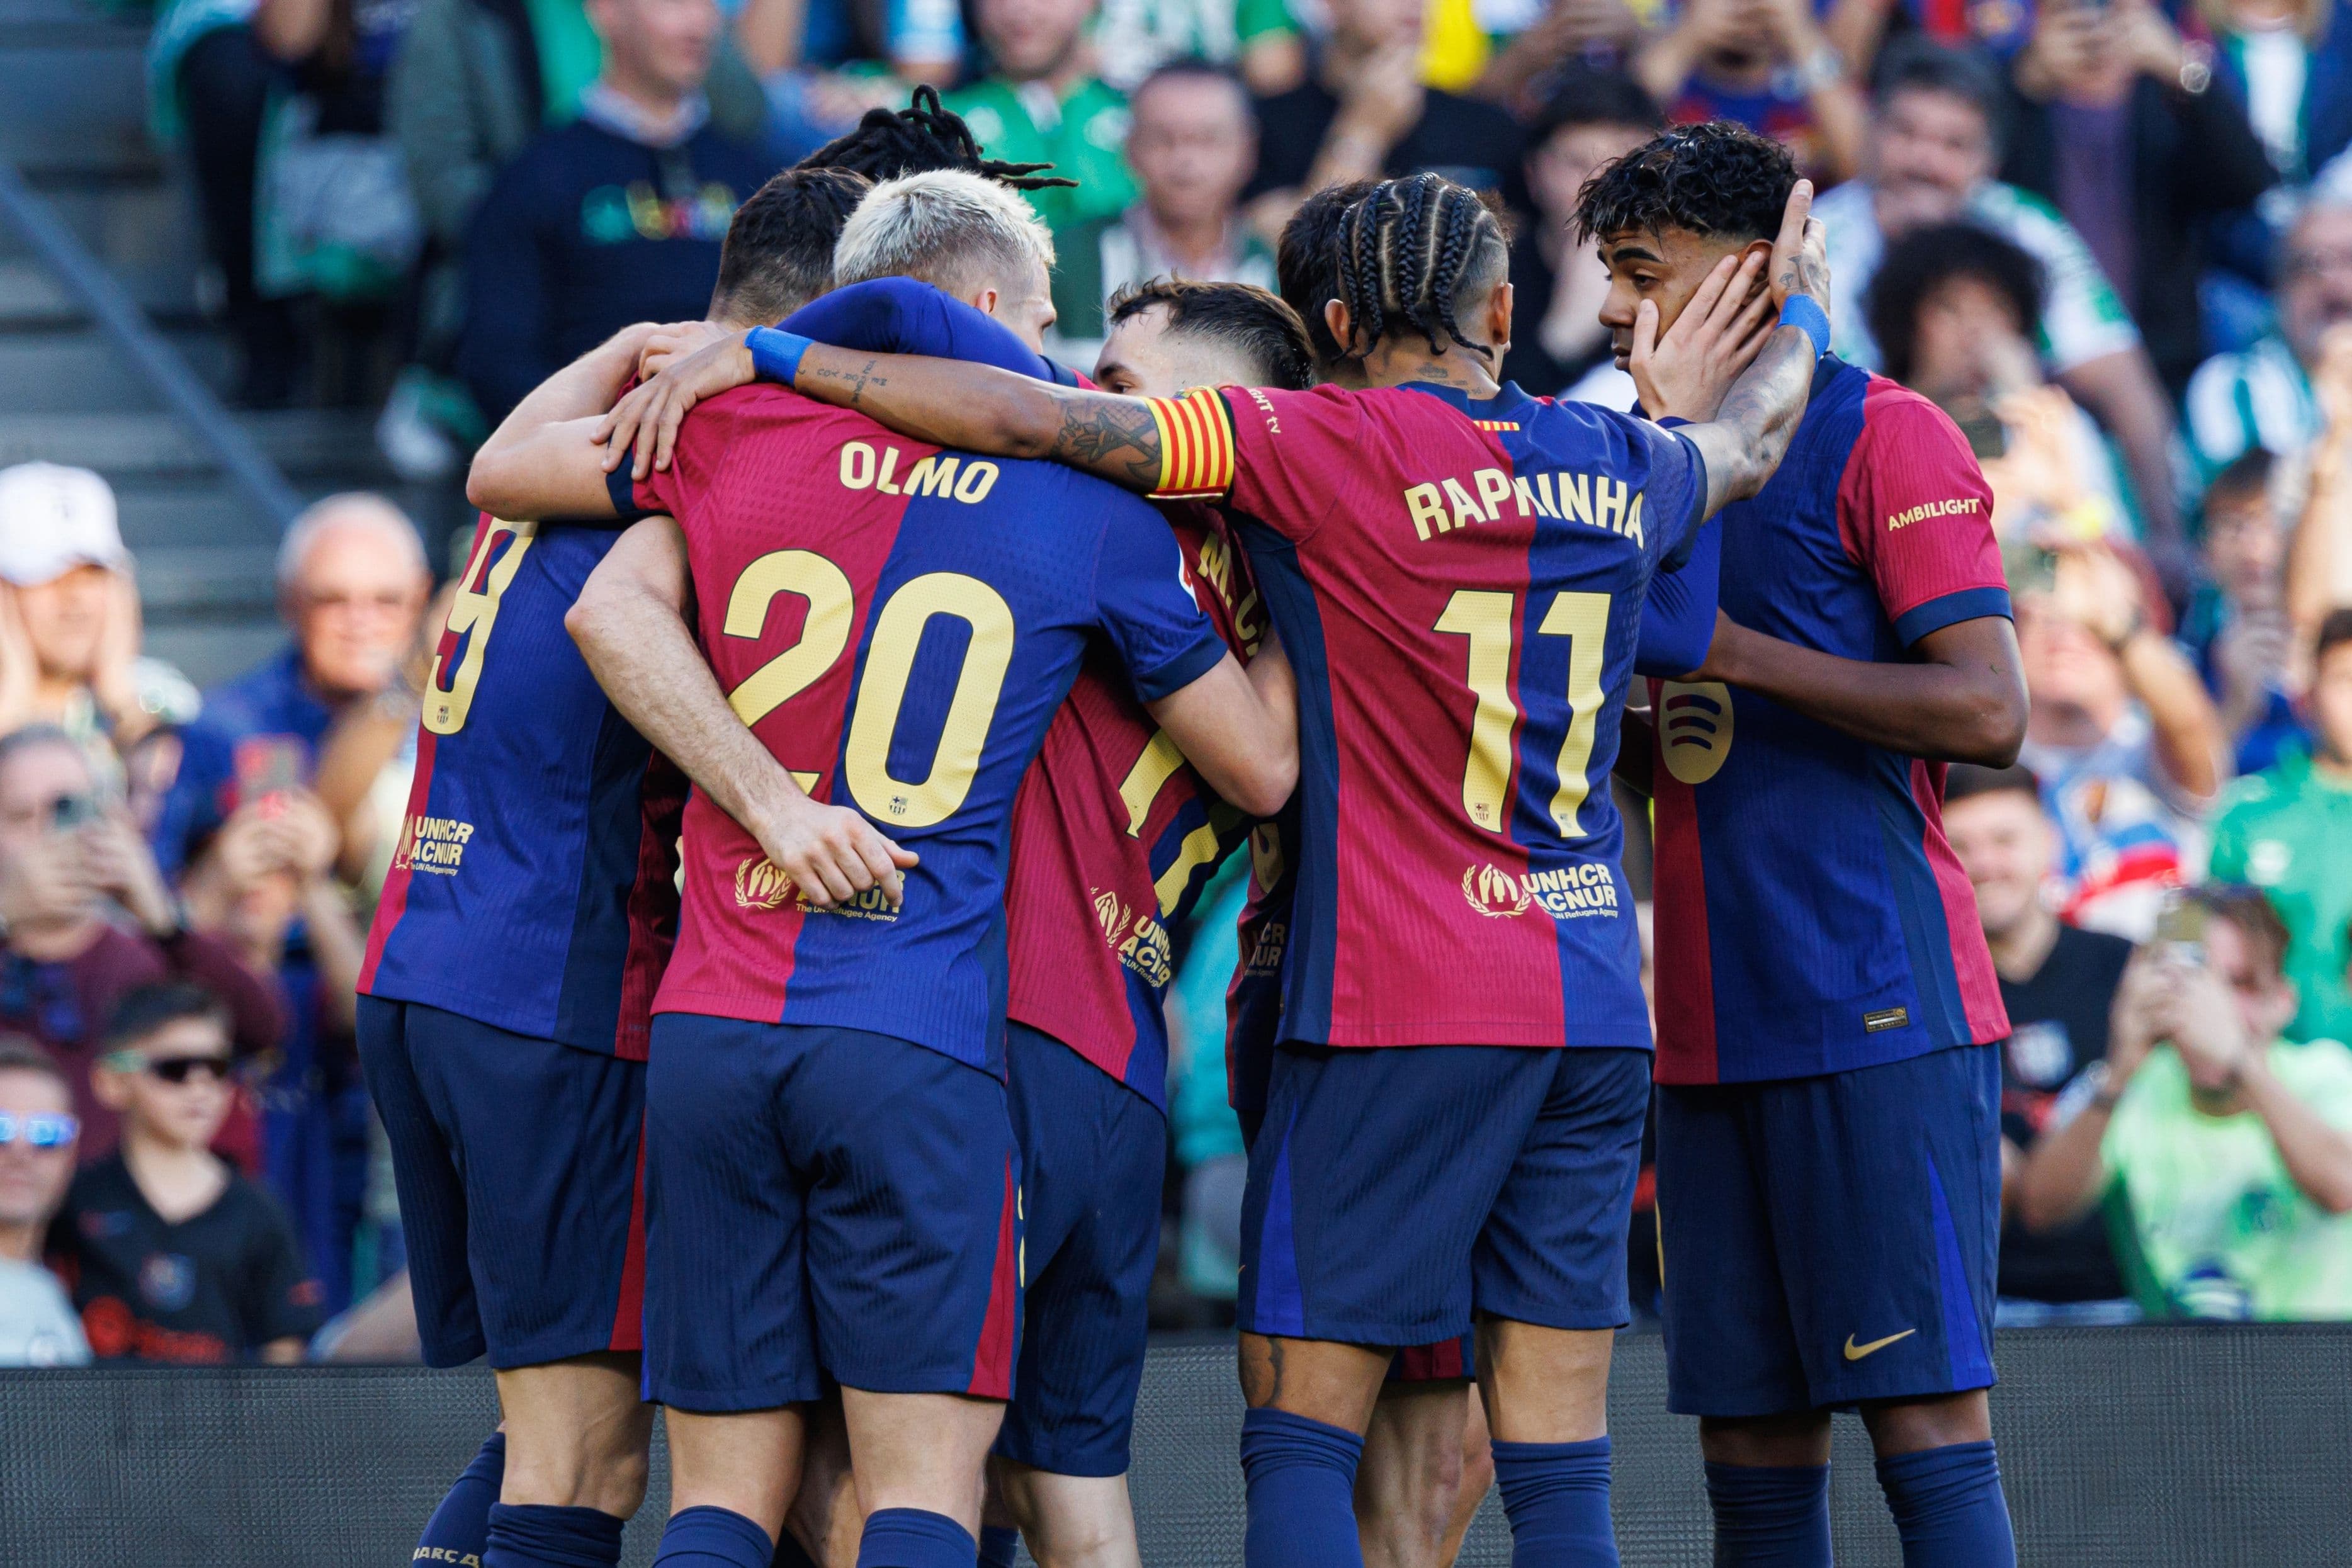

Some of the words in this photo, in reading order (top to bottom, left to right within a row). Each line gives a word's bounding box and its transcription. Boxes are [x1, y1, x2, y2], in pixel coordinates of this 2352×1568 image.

[840, 442, 999, 504] OLMO
[1889, 499, 1980, 531] AMBILIGHT
[421, 515, 538, 735] 9
[723, 549, 1015, 828] 20
[1431, 590, 1612, 837] 11
[415, 816, 474, 843] UNHCR
[1520, 864, 1613, 893] UNHCR
[1532, 885, 1618, 911] ACNUR
[796, 903, 812, 912] The
[831, 906, 863, 917] efugee
[864, 911, 898, 922] Agency
[1134, 915, 1171, 962] UNHC
